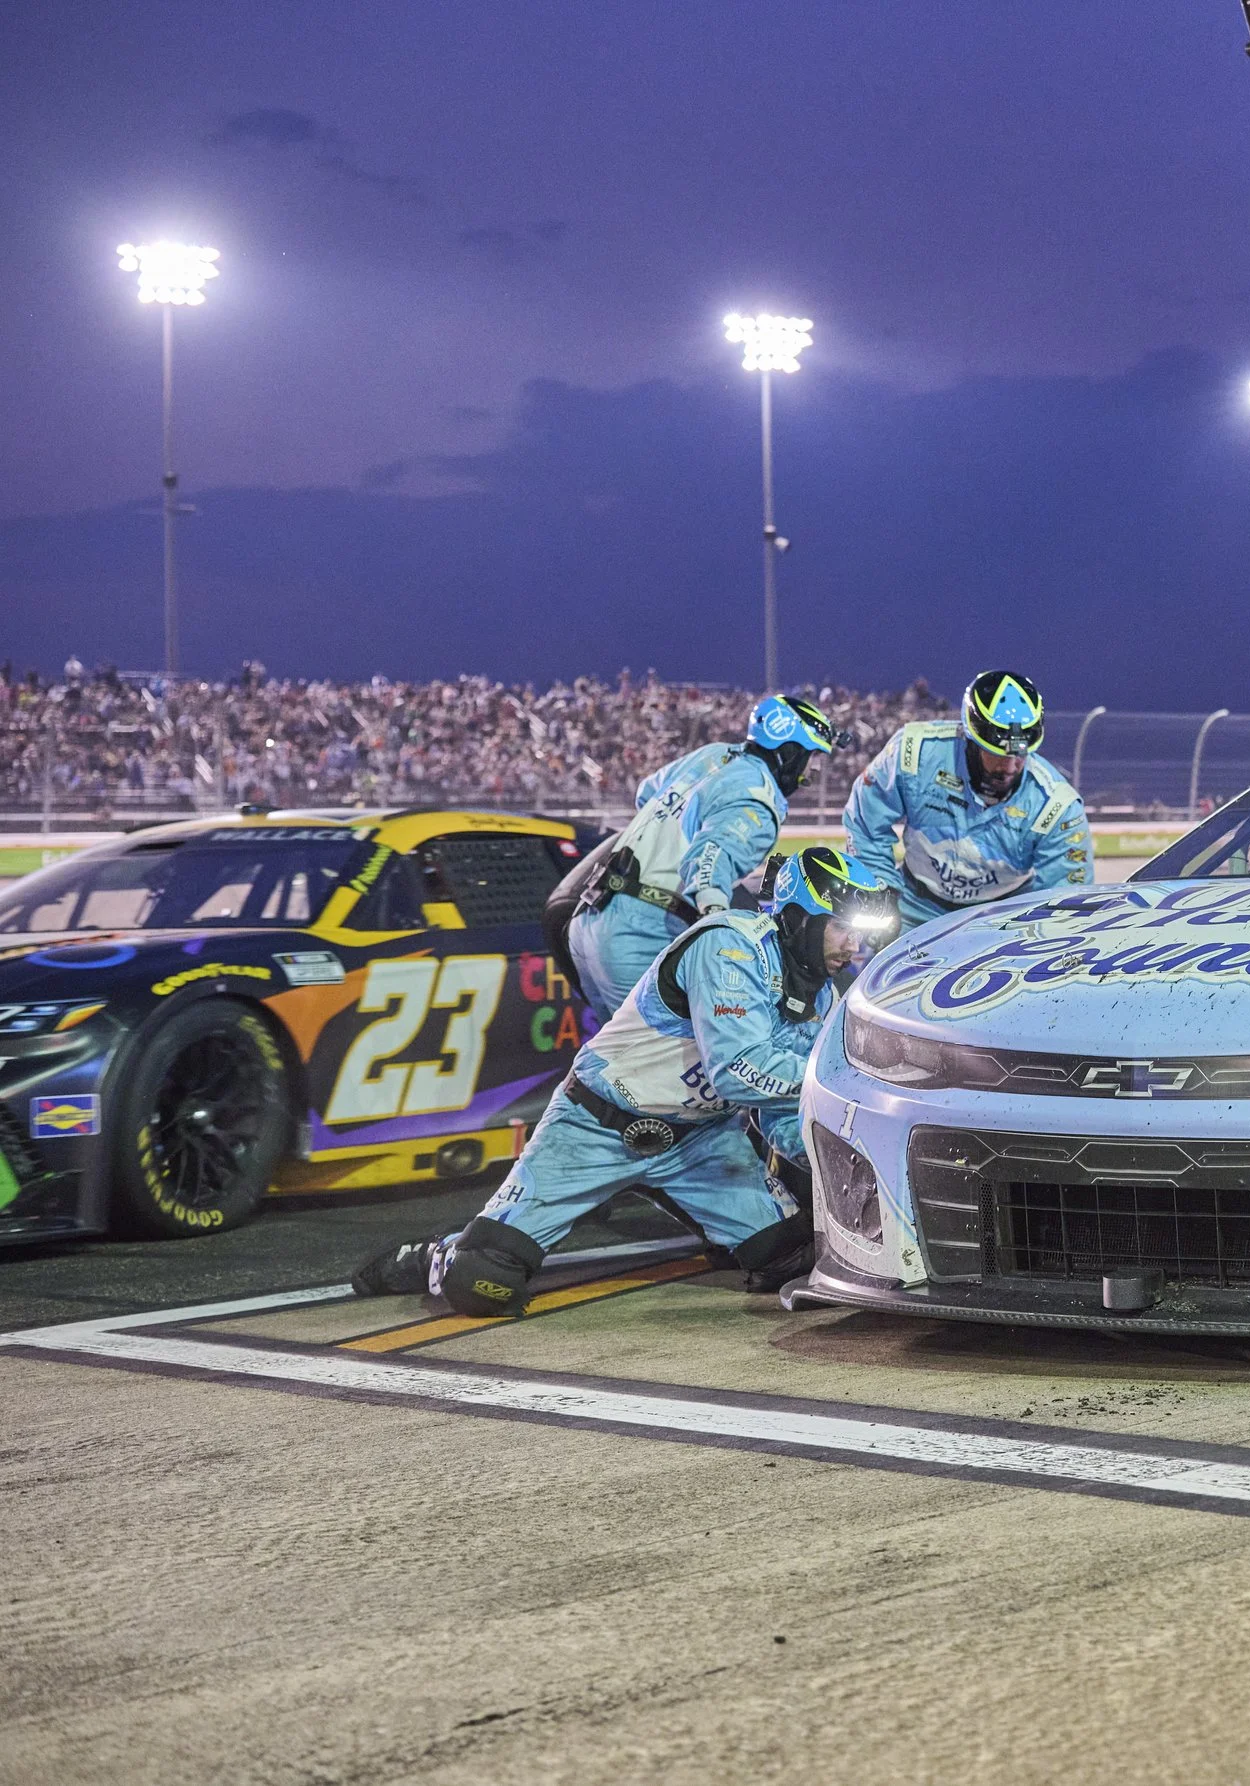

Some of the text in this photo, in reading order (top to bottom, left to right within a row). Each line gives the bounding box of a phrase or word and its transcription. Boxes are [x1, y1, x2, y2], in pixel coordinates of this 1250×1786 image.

[211, 829, 351, 842] WALLACE
[323, 954, 507, 1126] 23
[730, 1058, 775, 1092] BUSCH
[612, 1079, 641, 1110] sparco
